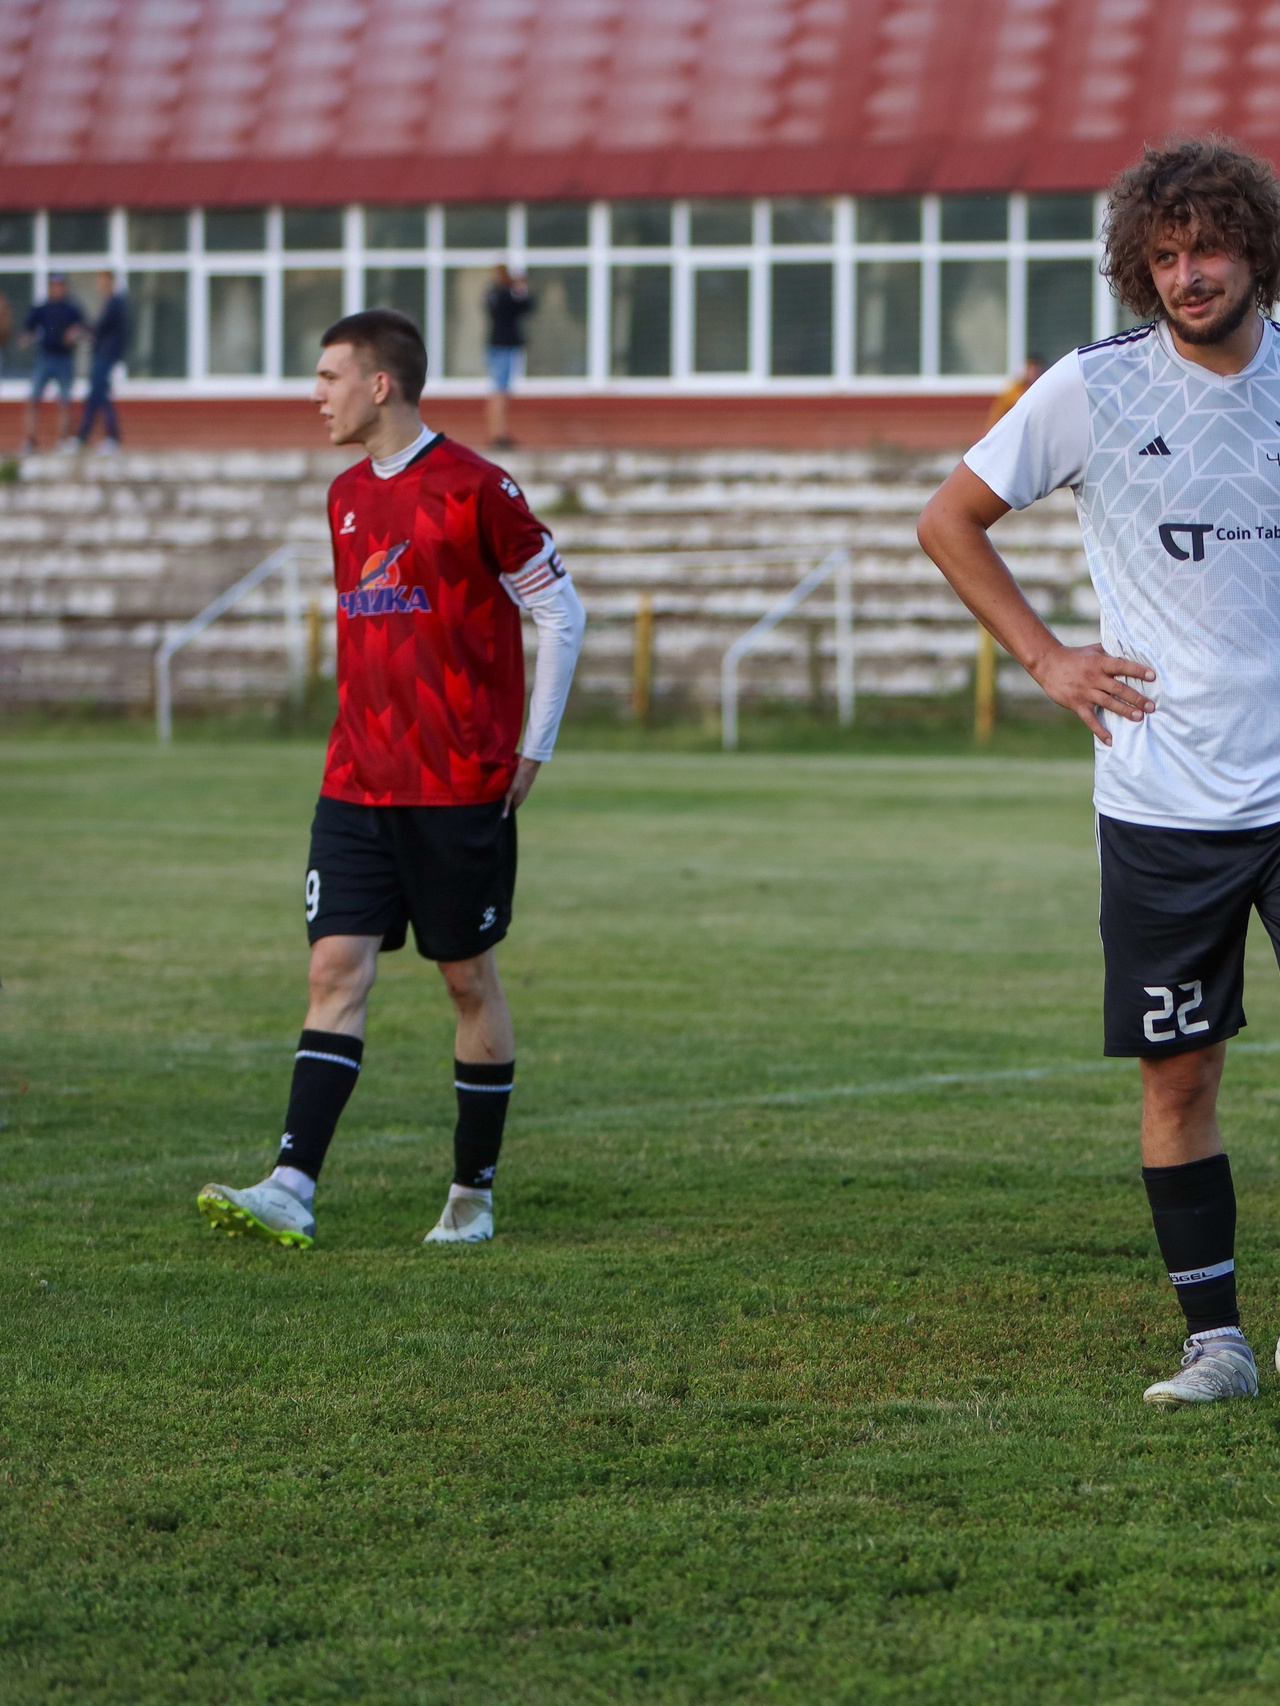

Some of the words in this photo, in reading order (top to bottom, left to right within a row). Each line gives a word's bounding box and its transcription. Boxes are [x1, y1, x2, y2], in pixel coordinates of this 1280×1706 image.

[1215, 527, 1251, 541] Coin
[339, 582, 431, 619] ЧАЙКА
[305, 869, 321, 923] 9
[1143, 979, 1210, 1043] 22
[1169, 1271, 1213, 1283] ÖGEL
